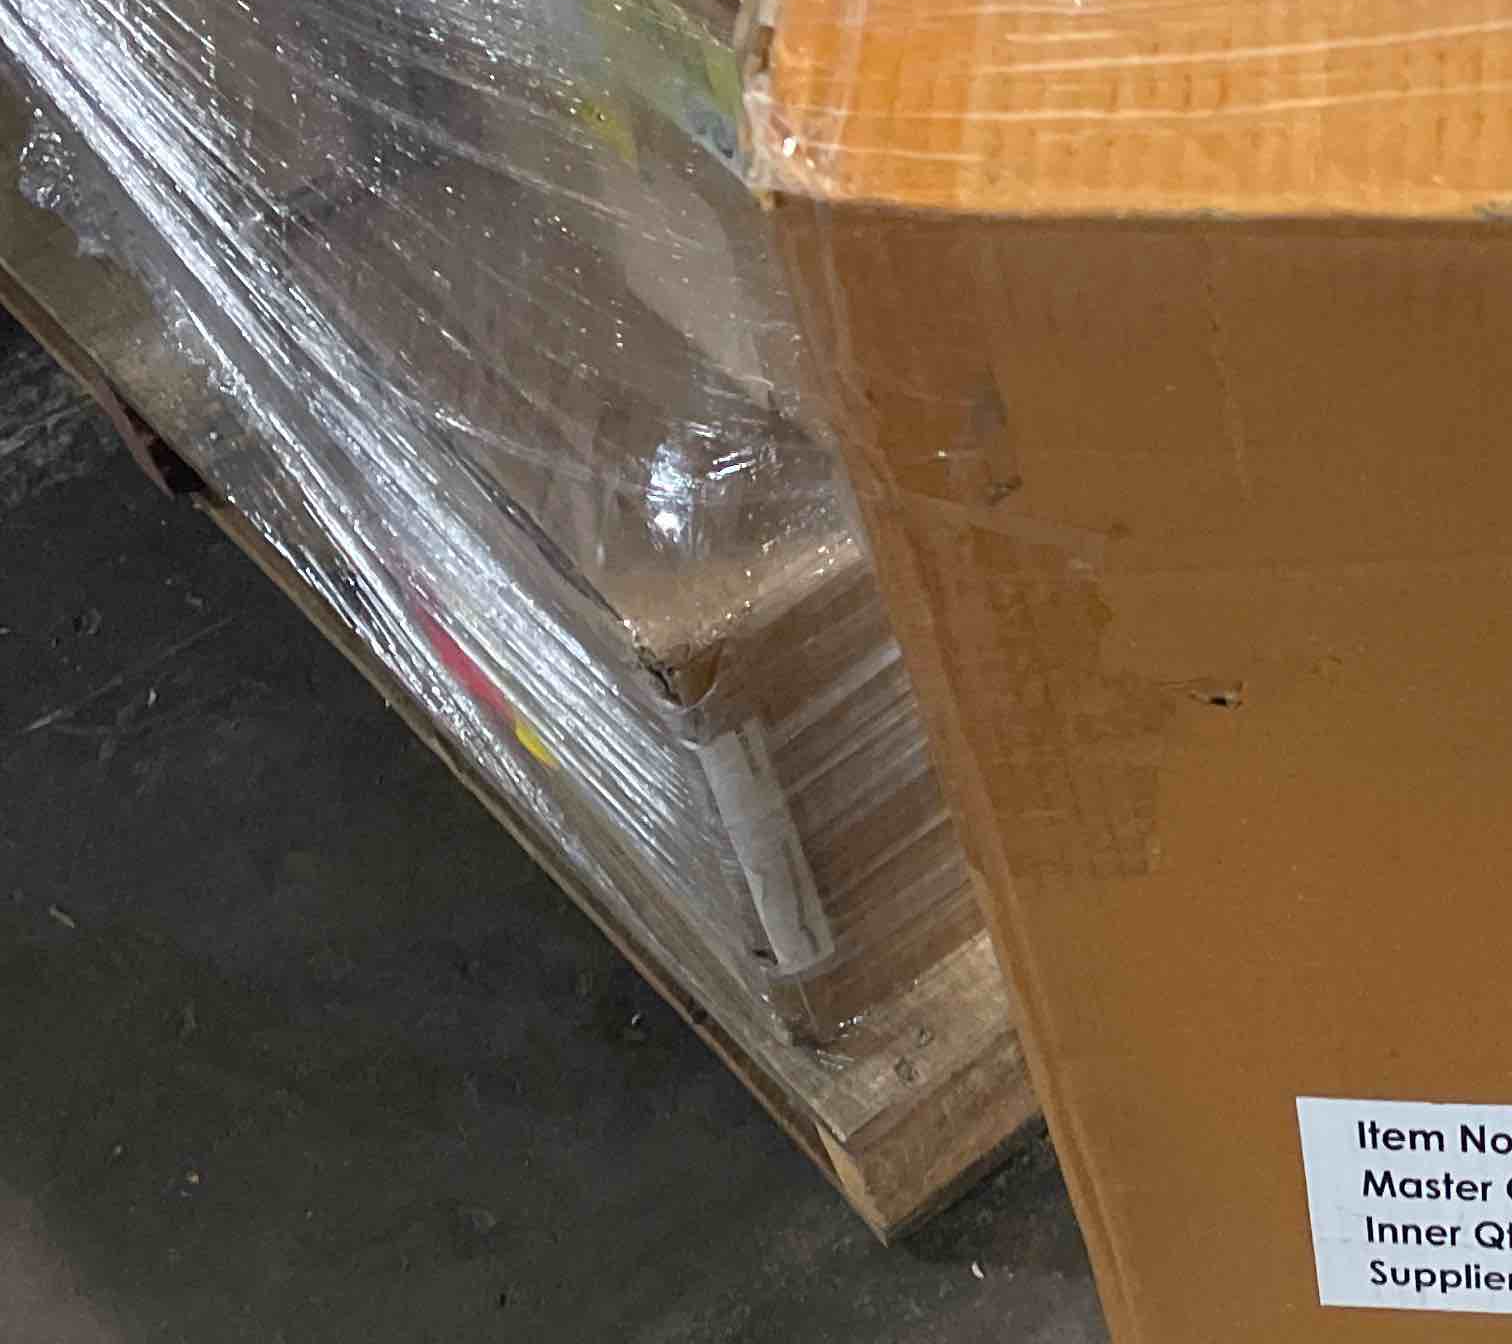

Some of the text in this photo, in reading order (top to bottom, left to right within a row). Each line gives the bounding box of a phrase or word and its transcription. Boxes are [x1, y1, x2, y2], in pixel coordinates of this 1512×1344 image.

[1357, 1120, 1445, 1153] Item
[1362, 1169, 1493, 1202] Master
[1366, 1215, 1462, 1247] Inner
